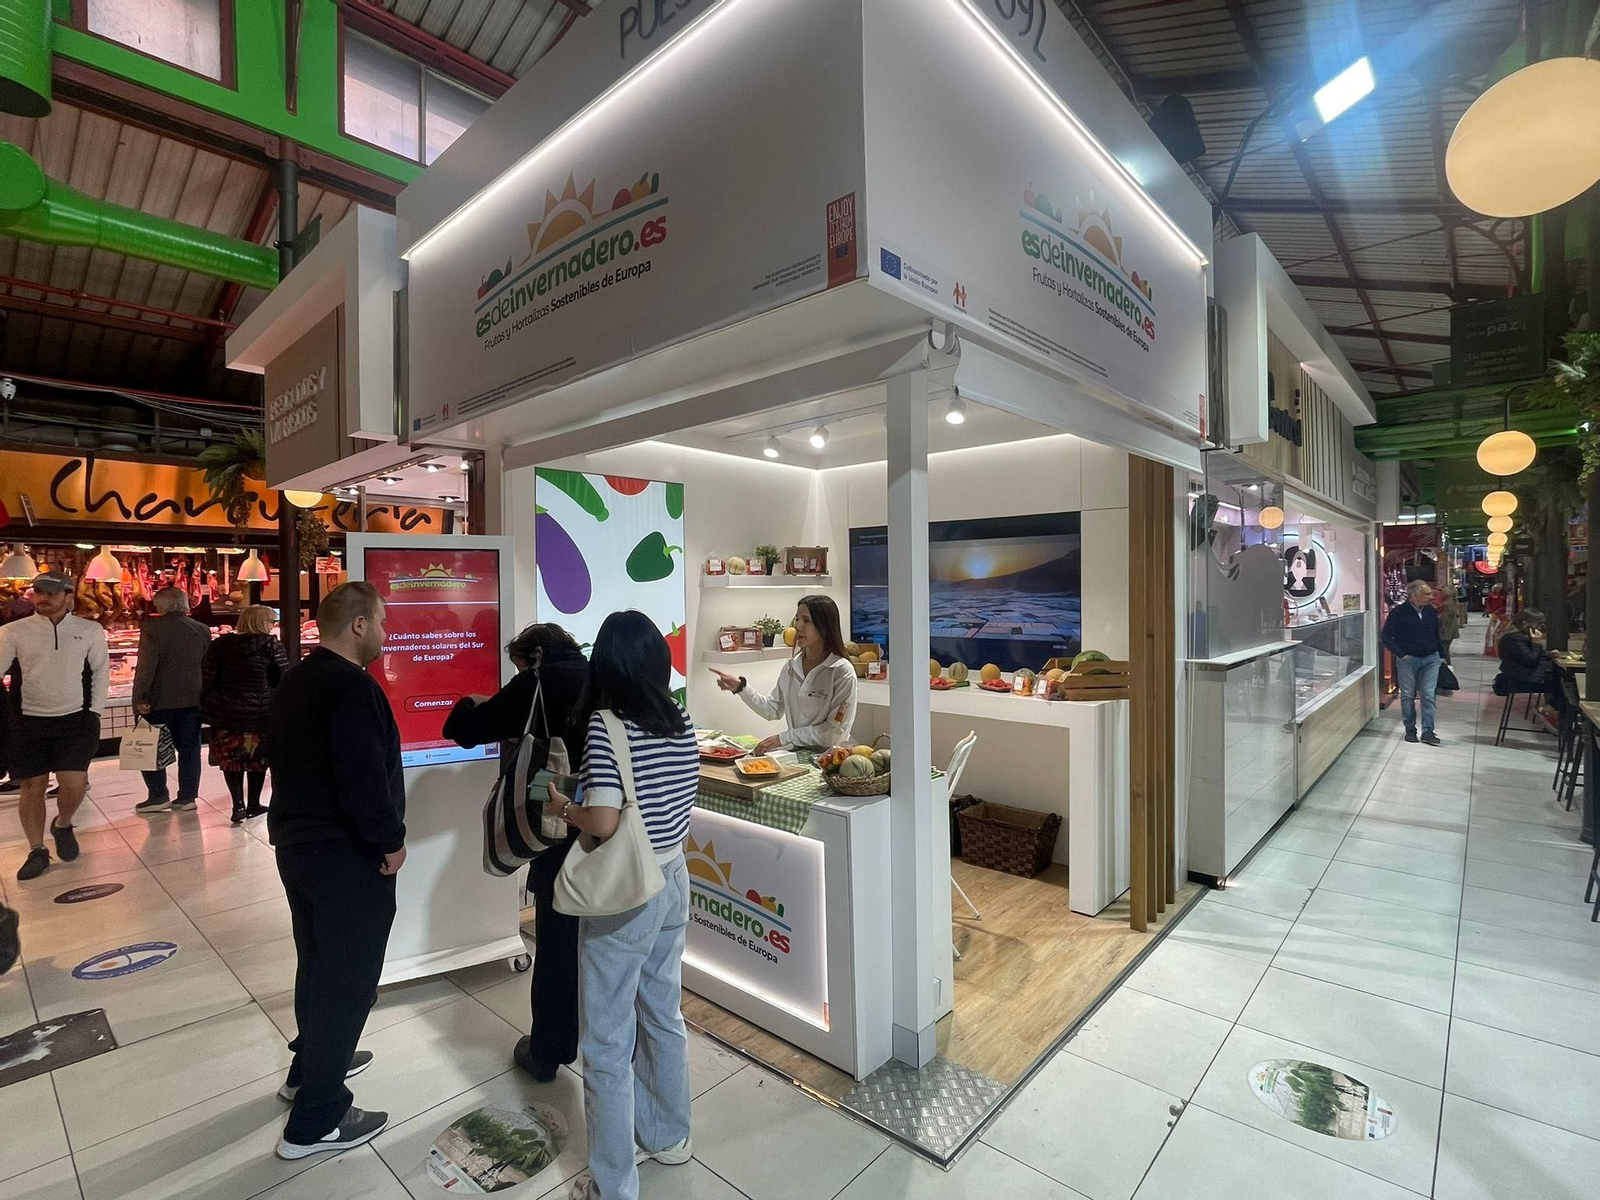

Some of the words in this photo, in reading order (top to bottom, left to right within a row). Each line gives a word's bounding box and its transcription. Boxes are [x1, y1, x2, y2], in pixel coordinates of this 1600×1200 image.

[829, 196, 854, 223] ENJOY
[829, 226, 854, 249] EUROPE
[476, 215, 667, 338] esdeinvernadero.es
[1021, 229, 1155, 341] esdeinvernadero.es
[484, 331, 506, 352] Frutas
[504, 327, 511, 341] y
[511, 303, 550, 335] Hortalizas
[550, 279, 600, 312] Sostenibles
[601, 273, 614, 288] de
[615, 260, 651, 284] Europa
[1033, 267, 1056, 291] Frutas
[1062, 282, 1095, 312] Hortalizas
[1094, 301, 1126, 334] Sostenibles
[1125, 325, 1133, 339] de
[1132, 330, 1150, 353] Europa
[1486, 321, 1519, 337] paz
[316, 366, 327, 390] Y
[381, 642, 431, 652] invernaderos
[432, 642, 458, 650] solares
[459, 641, 471, 649] del
[472, 641, 484, 649] Sur
[388, 631, 420, 641] ¿Cuánto
[421, 632, 442, 640] sabes
[444, 631, 464, 639] sobre
[413, 654, 423, 662] de
[424, 653, 454, 662] Europa?
[414, 699, 453, 708] Comenzar
[693, 913, 736, 941] Sostenibles
[736, 934, 748, 947] de
[748, 940, 778, 964] Europa
